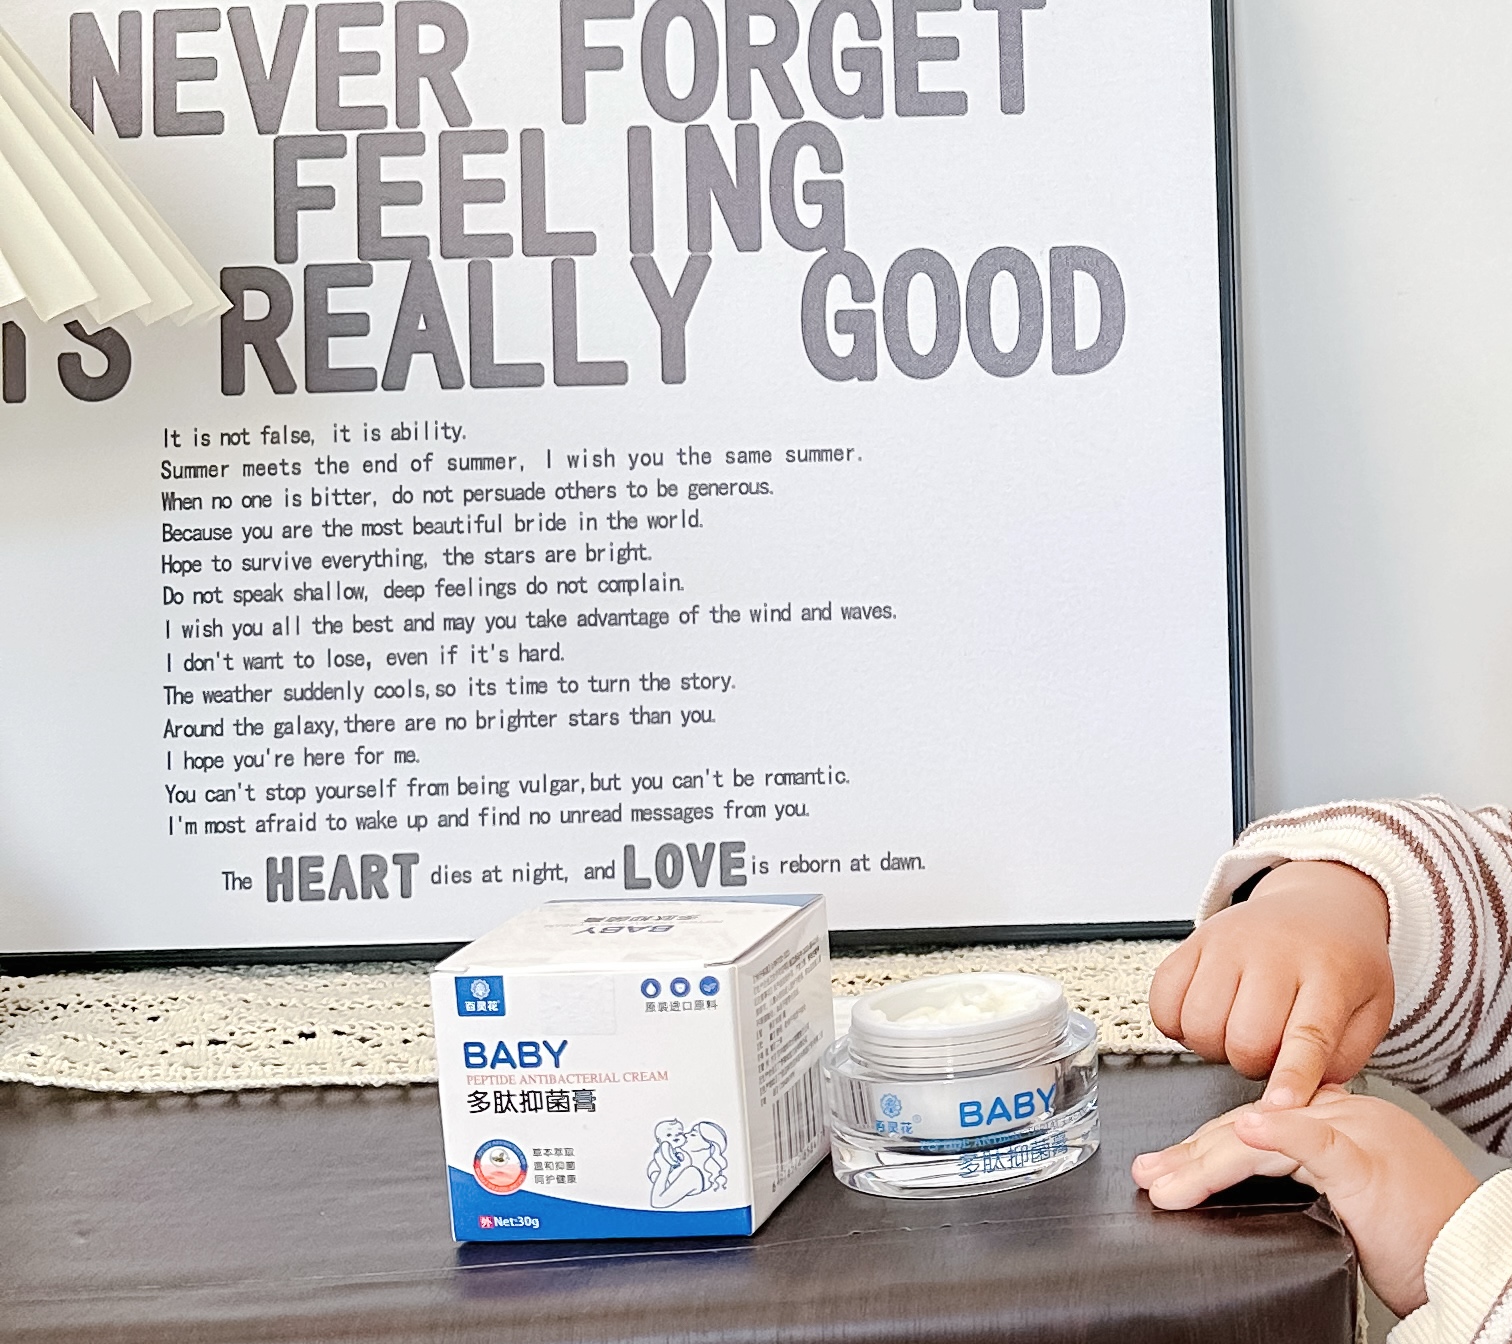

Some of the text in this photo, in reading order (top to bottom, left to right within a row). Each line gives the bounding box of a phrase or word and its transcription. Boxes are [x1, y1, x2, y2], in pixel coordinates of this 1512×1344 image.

[69, 0, 473, 139] NEVER
[273, 120, 845, 264] FEELING
[220, 253, 712, 396] REALLY
[801, 245, 1126, 382] GOOD
[164, 419, 467, 449] It is not false, it is ability.
[160, 445, 862, 480] Summer meets the end of summer, I wish you the same summer.
[160, 477, 774, 512] When no one is bitter, do not persuade others to be generous.
[162, 507, 704, 544] Because you are the most beautiful bride in the world.
[161, 541, 653, 578] Hope to survive everything, the stars are bright.
[165, 600, 897, 641] I wish you all the best and may you take advantage of the wind and waves.
[162, 685, 194, 706] The
[201, 683, 273, 705] weather
[283, 679, 365, 704] suddenly
[468, 676, 497, 697] its
[505, 675, 548, 696] time
[556, 675, 580, 694] to
[587, 675, 630, 693] turn
[638, 671, 671, 692] the
[680, 672, 736, 693] story.
[162, 717, 224, 740] Around
[232, 716, 265, 737] the
[404, 717, 436, 732] are
[445, 716, 468, 731] no
[475, 708, 558, 733] brighter
[568, 708, 620, 727] stars
[628, 704, 672, 726] than
[680, 709, 716, 728] you.
[167, 744, 421, 774] I hope you're here for me.
[164, 783, 197, 804] You
[204, 781, 256, 803] can't
[265, 782, 307, 805] stop
[314, 777, 398, 804] yourself
[406, 776, 450, 798] from
[457, 774, 510, 799] being
[630, 775, 663, 795] you
[672, 768, 724, 790] can't
[732, 767, 755, 788] be
[765, 764, 850, 787] romantic.
[168, 799, 810, 836] I'm most afraid to wake up and find no unread messages from you.
[221, 841, 926, 904] The HEART dies at night, and LOVE is reborn at dawn.
[463, 1039, 568, 1070] BABY
[466, 1070, 669, 1086] PEPTIDE ANTIBACTERIAL CREAM
[466, 1088, 597, 1114] 多肽抑菌膏
[959, 1083, 1056, 1128] BABY
